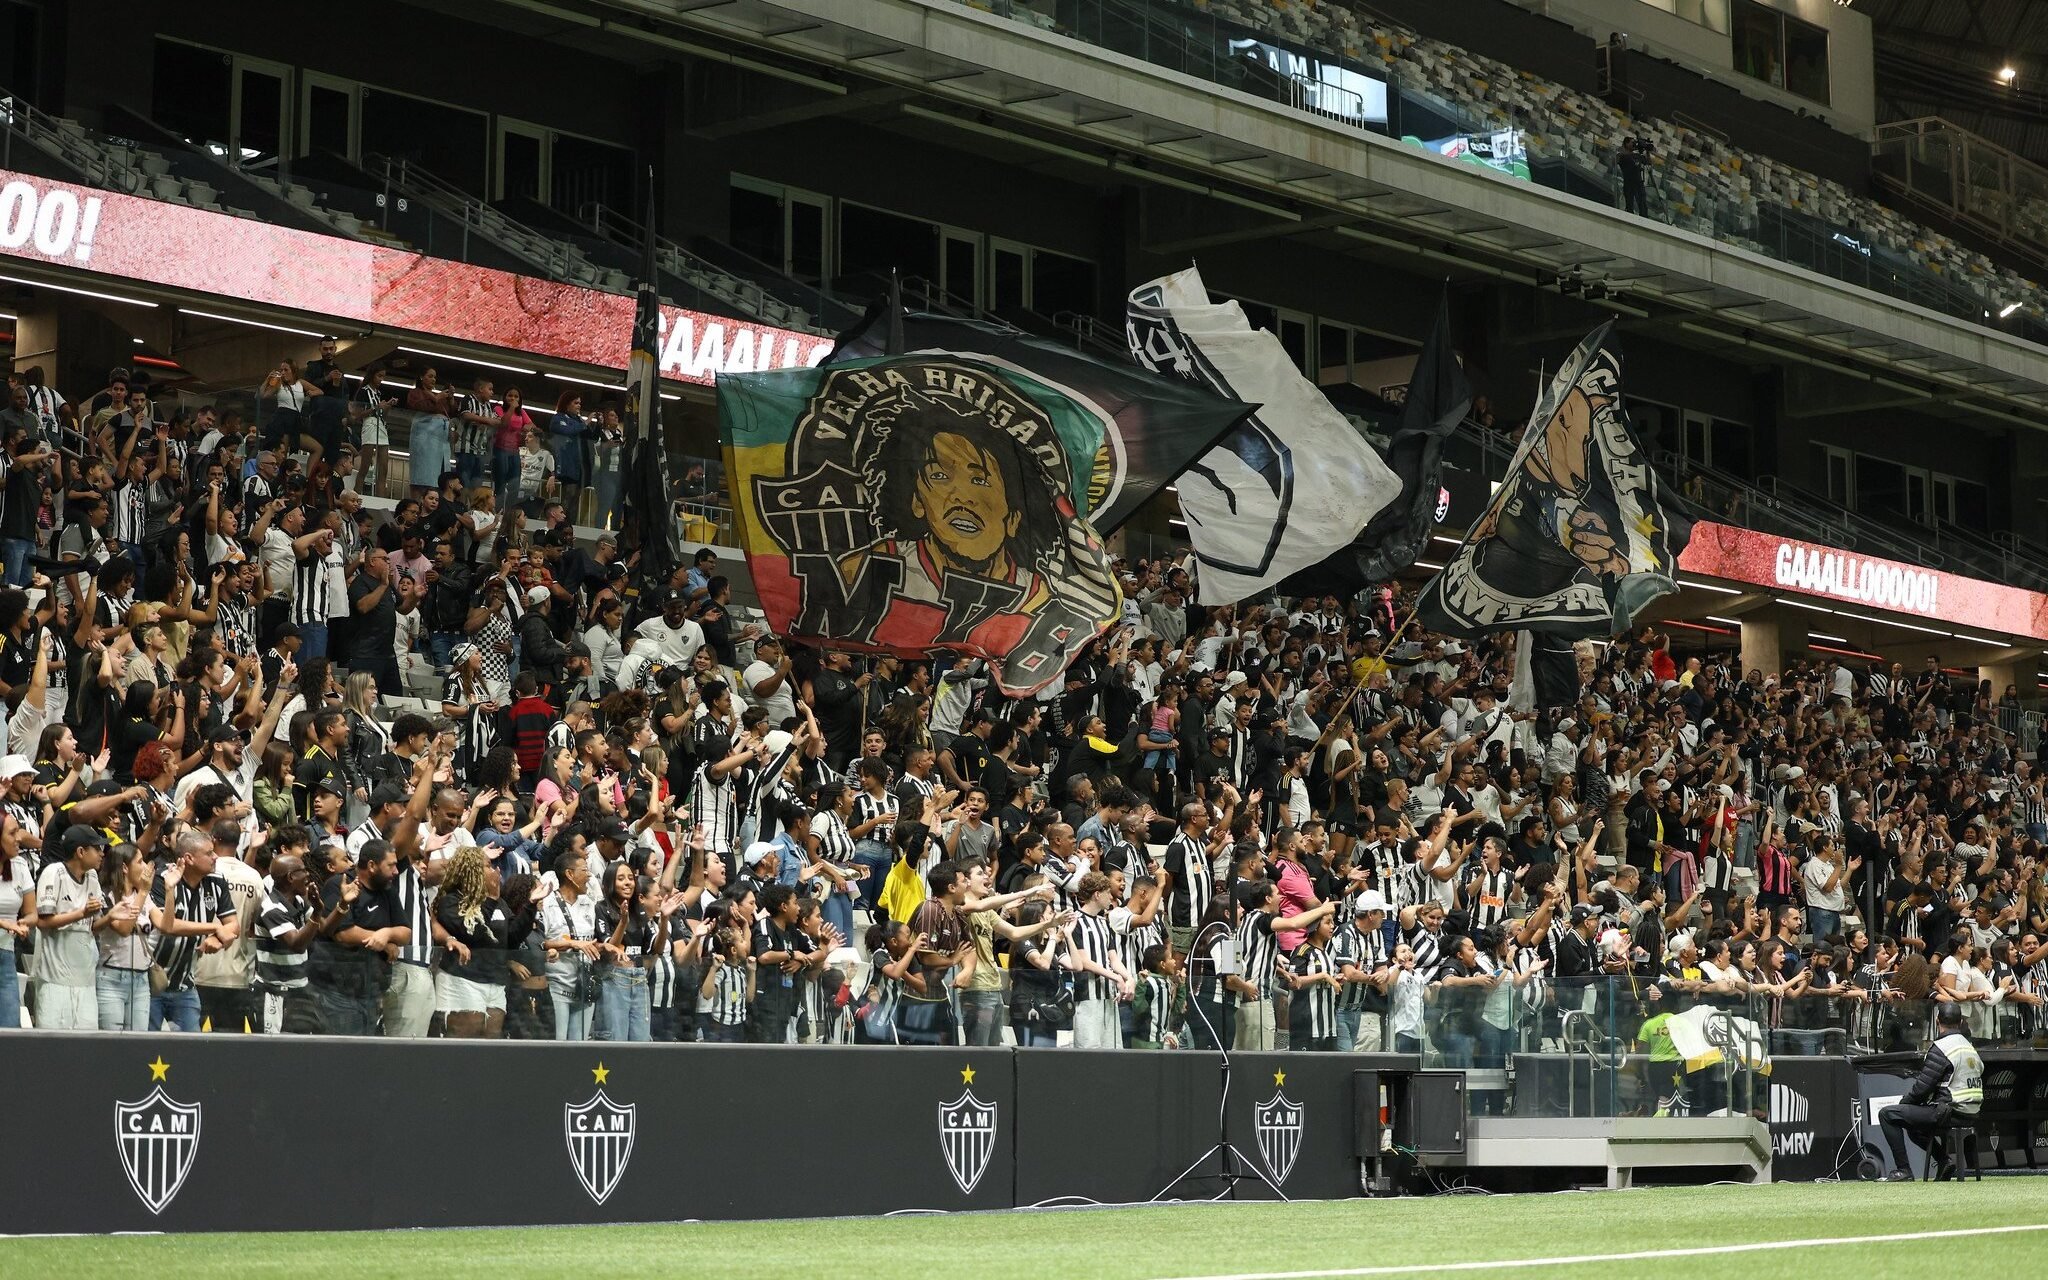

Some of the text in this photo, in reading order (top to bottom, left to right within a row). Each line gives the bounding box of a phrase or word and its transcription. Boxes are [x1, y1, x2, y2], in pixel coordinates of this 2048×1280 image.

[815, 369, 912, 440] VELHA
[923, 368, 1066, 493] BRIGAD
[1775, 543, 1938, 614] GAAALLOOOOO!
[1481, 895, 1505, 906] BMG
[129, 1113, 189, 1133] CAM
[576, 1114, 626, 1132] CAM
[948, 1111, 990, 1128] CAM
[1262, 1111, 1297, 1126] CAM
